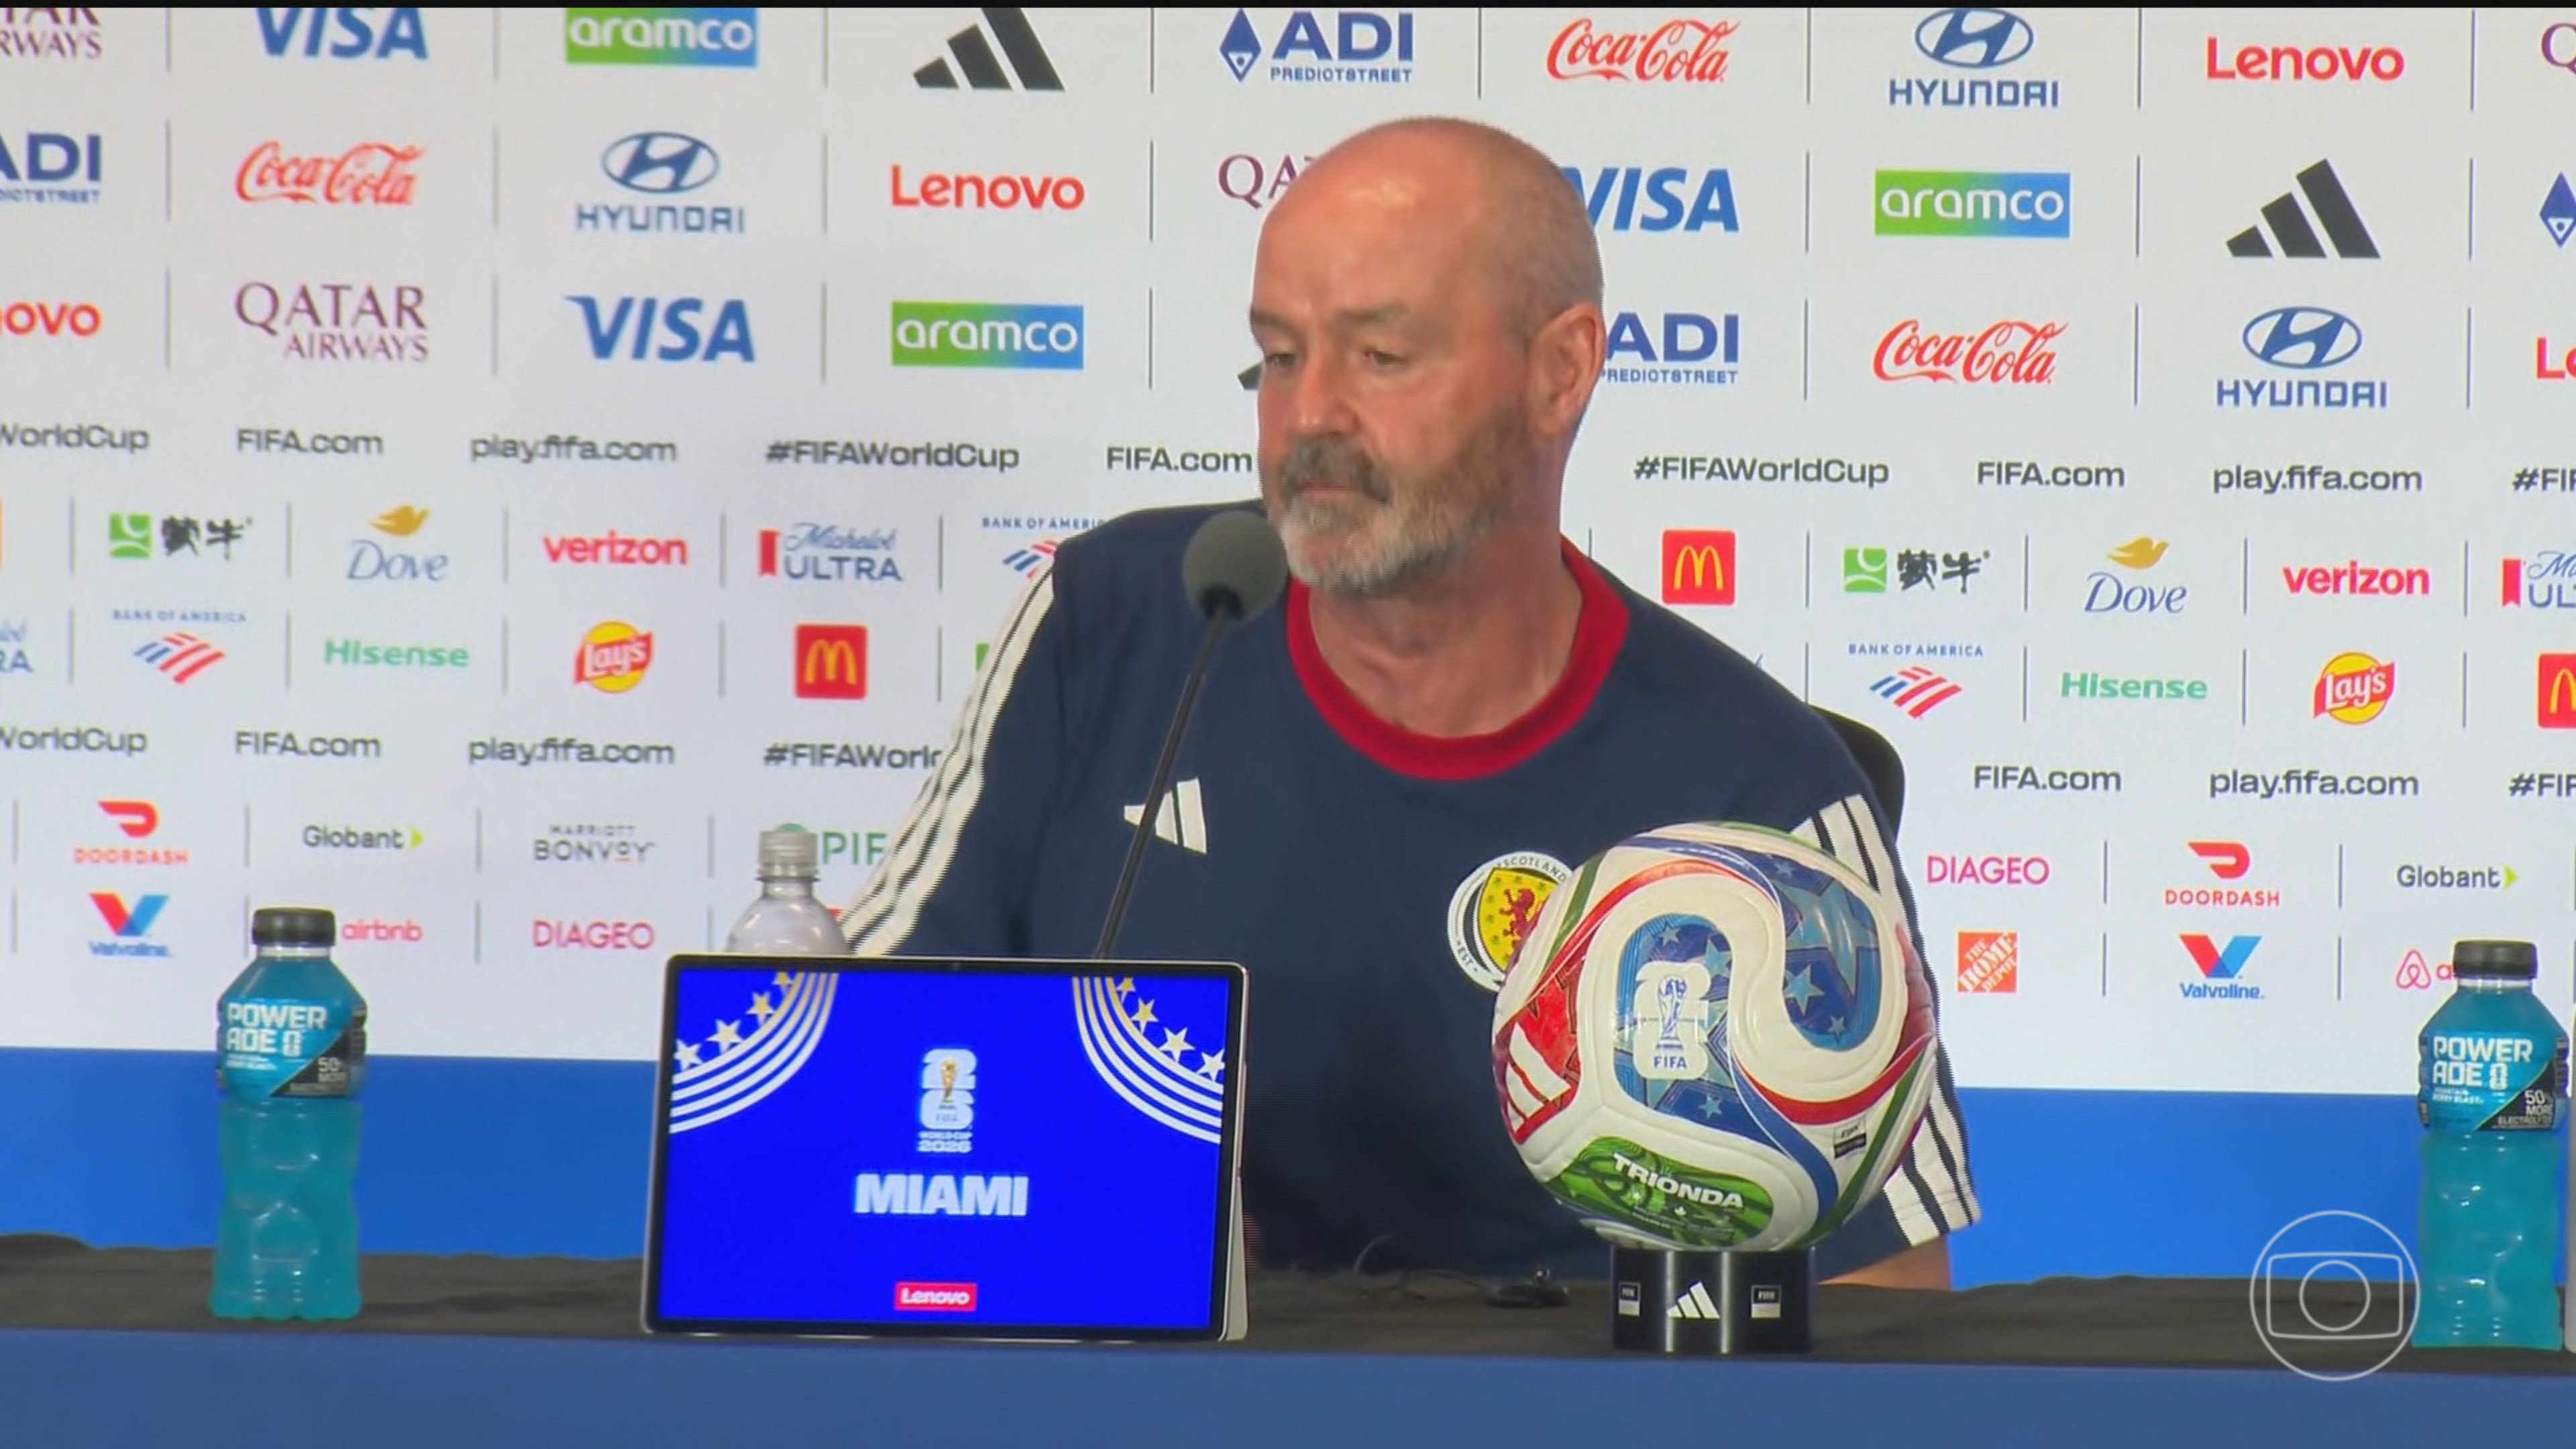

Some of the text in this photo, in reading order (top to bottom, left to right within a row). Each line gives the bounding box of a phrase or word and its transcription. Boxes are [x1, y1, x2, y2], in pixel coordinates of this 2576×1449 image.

[256, 8, 428, 60] VISA
[570, 17, 754, 50] aramco
[1272, 11, 1413, 62] ADI
[2207, 37, 2404, 80] Lenovo
[1890, 79, 2058, 107] HYUNDAI
[892, 164, 1084, 210] Lenovo
[577, 205, 745, 233] HYUNDAI
[1882, 189, 2063, 220] aramco
[5, 301, 103, 337] ovo
[235, 282, 428, 335] QATAR
[567, 296, 755, 362] VISA
[898, 319, 1077, 352] aramco
[1606, 311, 1739, 363] ADI
[284, 333, 428, 362] AIRWAYS
[1602, 368, 1737, 384] REDICTSTREET
[2217, 380, 2386, 408] HYUNDAI
[237, 428, 384, 454] FIFA.com
[472, 435, 677, 464] play.fifa.com
[765, 440, 1019, 473] #FIFAWorldCup
[1107, 446, 1252, 472] FIFA.com
[1633, 456, 1888, 488] #FIFAWorldCup
[1978, 461, 2125, 486] FIFA.com
[2214, 465, 2422, 494] play.fifa.com
[347, 539, 448, 581] Dove
[543, 530, 688, 565] verizon
[785, 556, 902, 581] ULTRA
[2283, 560, 2429, 595] verizon
[2085, 572, 2186, 612] Dove
[325, 639, 470, 668] Hisense
[1848, 643, 1984, 657] BANK OF AMERICA
[2061, 673, 2208, 700] Hisense
[236, 731, 382, 757] FIFA.com
[469, 737, 675, 766] play.fifa.com
[1974, 765, 2121, 791] FIFA.com
[2210, 769, 2418, 799] play.fifa.com
[303, 824, 405, 849] Globant
[822, 831, 888, 865] PIF
[1927, 855, 2049, 885] DIAGEO
[2396, 865, 2500, 888] Globant
[2165, 889, 2279, 906] DOORDASH
[342, 920, 423, 941] airbnb
[533, 920, 655, 950] DIAGEO
[1958, 932, 2014, 993] HOME
[227, 1002, 327, 1029] POWER
[225, 1028, 276, 1053] ADE
[2433, 1036, 2533, 1063] POWER
[1654, 1056, 1687, 1069] FIFA
[2432, 1061, 2483, 1086] ADE
[1613, 1152, 1743, 1208] TRIONDA
[855, 1174, 1028, 1216] MIAMI
[902, 1289, 969, 1304] Lenovo
